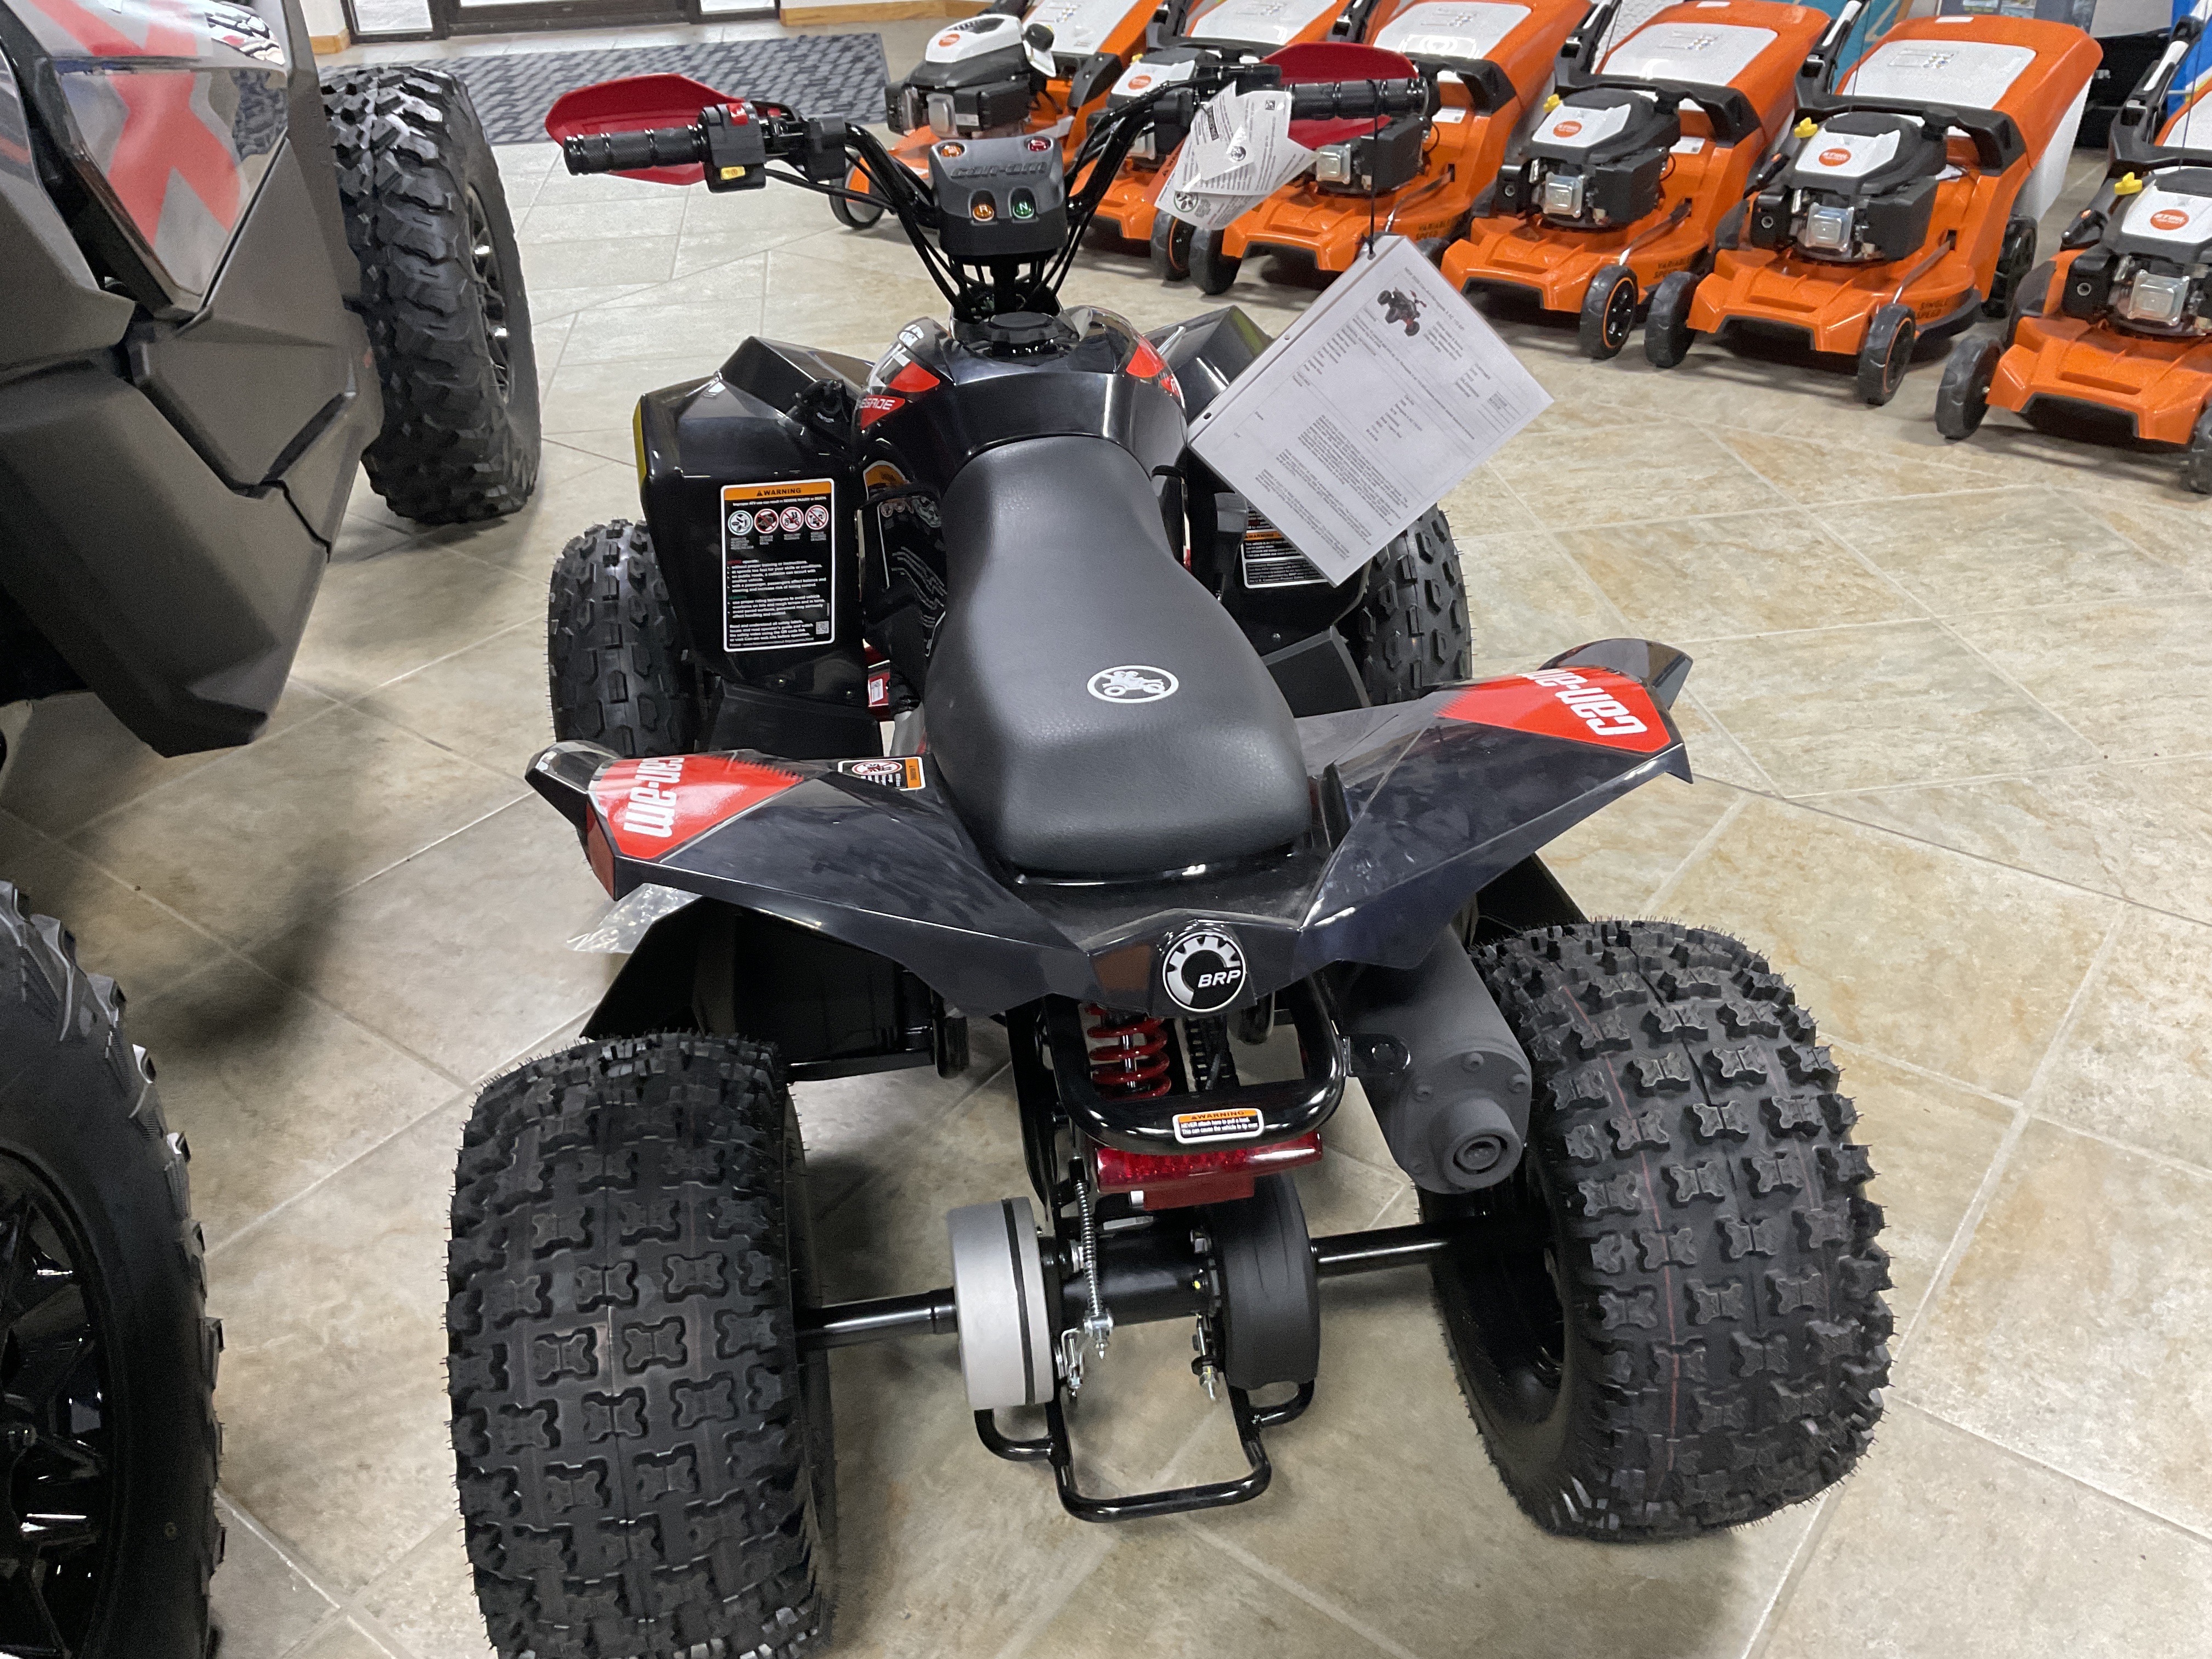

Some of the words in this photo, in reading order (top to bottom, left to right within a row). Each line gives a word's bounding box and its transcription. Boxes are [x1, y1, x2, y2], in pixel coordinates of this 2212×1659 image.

[1019, 201, 1028, 211] N
[764, 487, 802, 496] WARNING
[1198, 969, 1241, 988] BRP
[1198, 1111, 1245, 1119] WARNING
